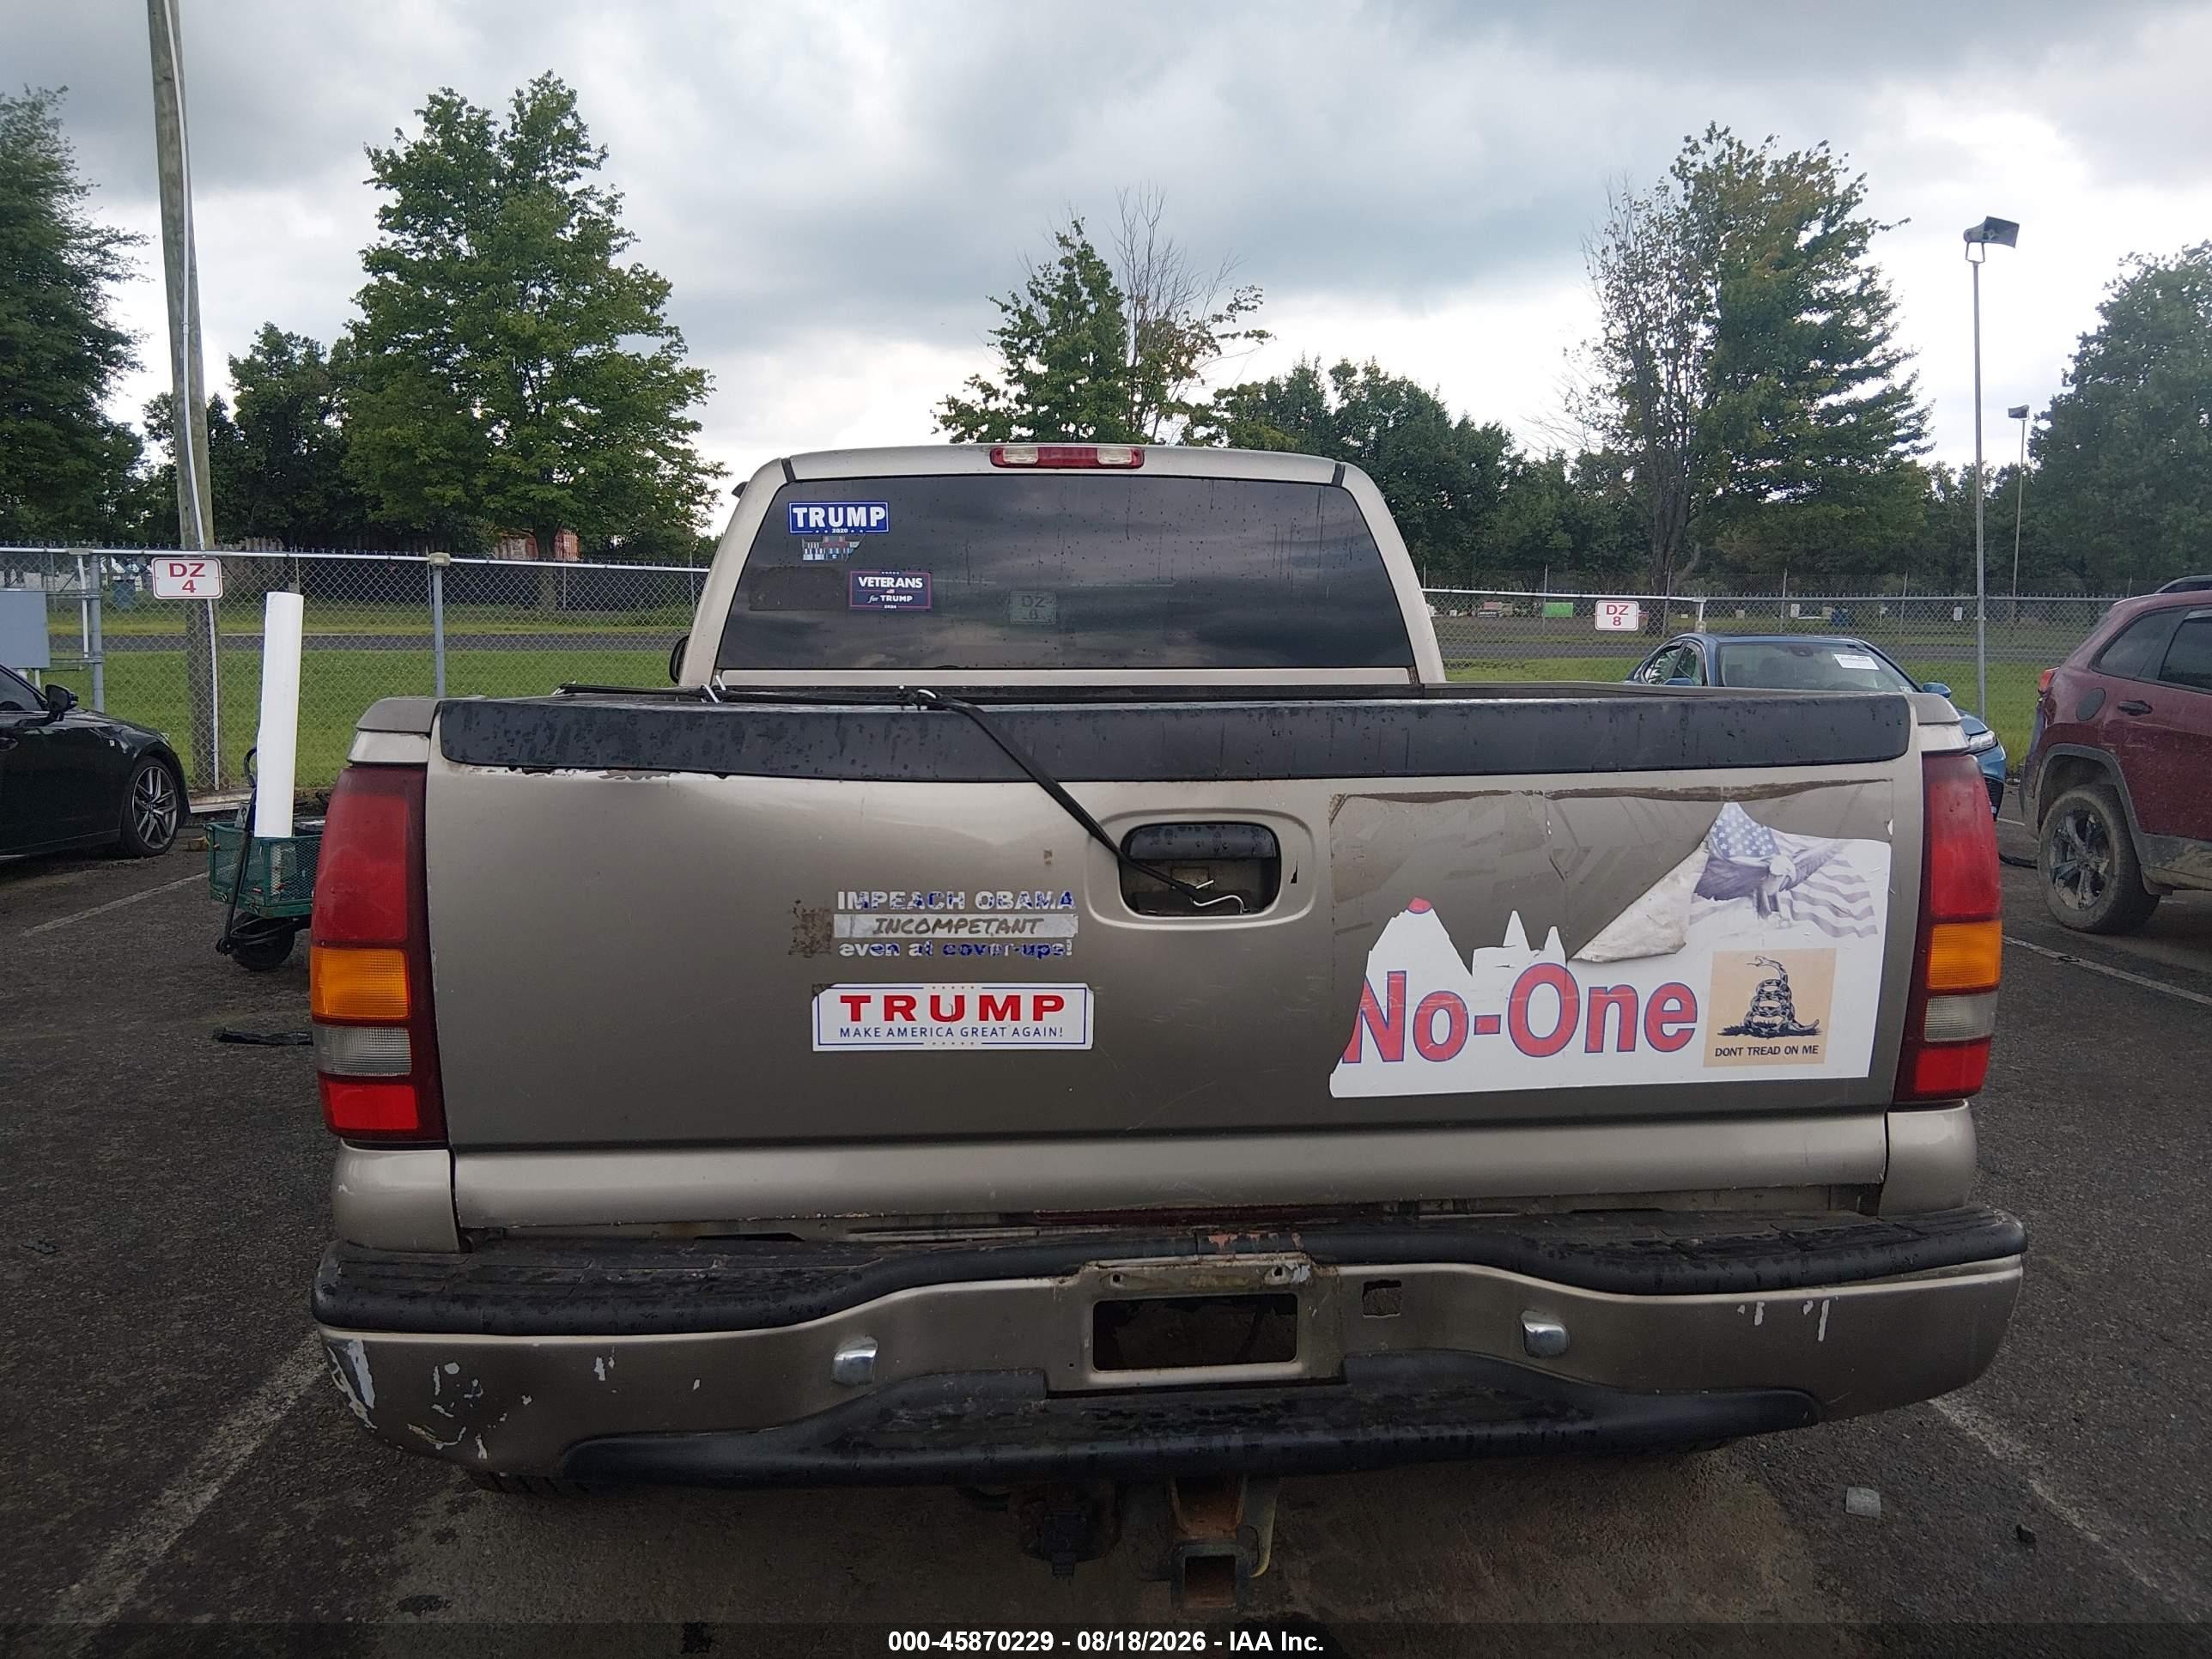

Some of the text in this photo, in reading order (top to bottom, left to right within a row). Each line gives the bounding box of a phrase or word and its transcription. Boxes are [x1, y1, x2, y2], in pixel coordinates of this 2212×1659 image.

[793, 507, 886, 528] TRUMP
[168, 562, 206, 578] DZ
[181, 579, 198, 593] 4
[858, 576, 923, 588] VETERANS
[867, 594, 879, 604] for
[1606, 605, 1629, 616] DZ
[1613, 617, 1622, 626] 8
[838, 890, 1076, 910] IMPEACH OBAMA
[872, 917, 1044, 936] INCOMPETANT
[839, 939, 1073, 959] even at cover-ups!
[840, 994, 1065, 1023] TRUMP
[1341, 962, 1698, 1065] No-One
[839, 1026, 1064, 1038] MAKE AMERICA GREAT AGAIN!
[1715, 1045, 1820, 1057] DONT TREAD ON ME
